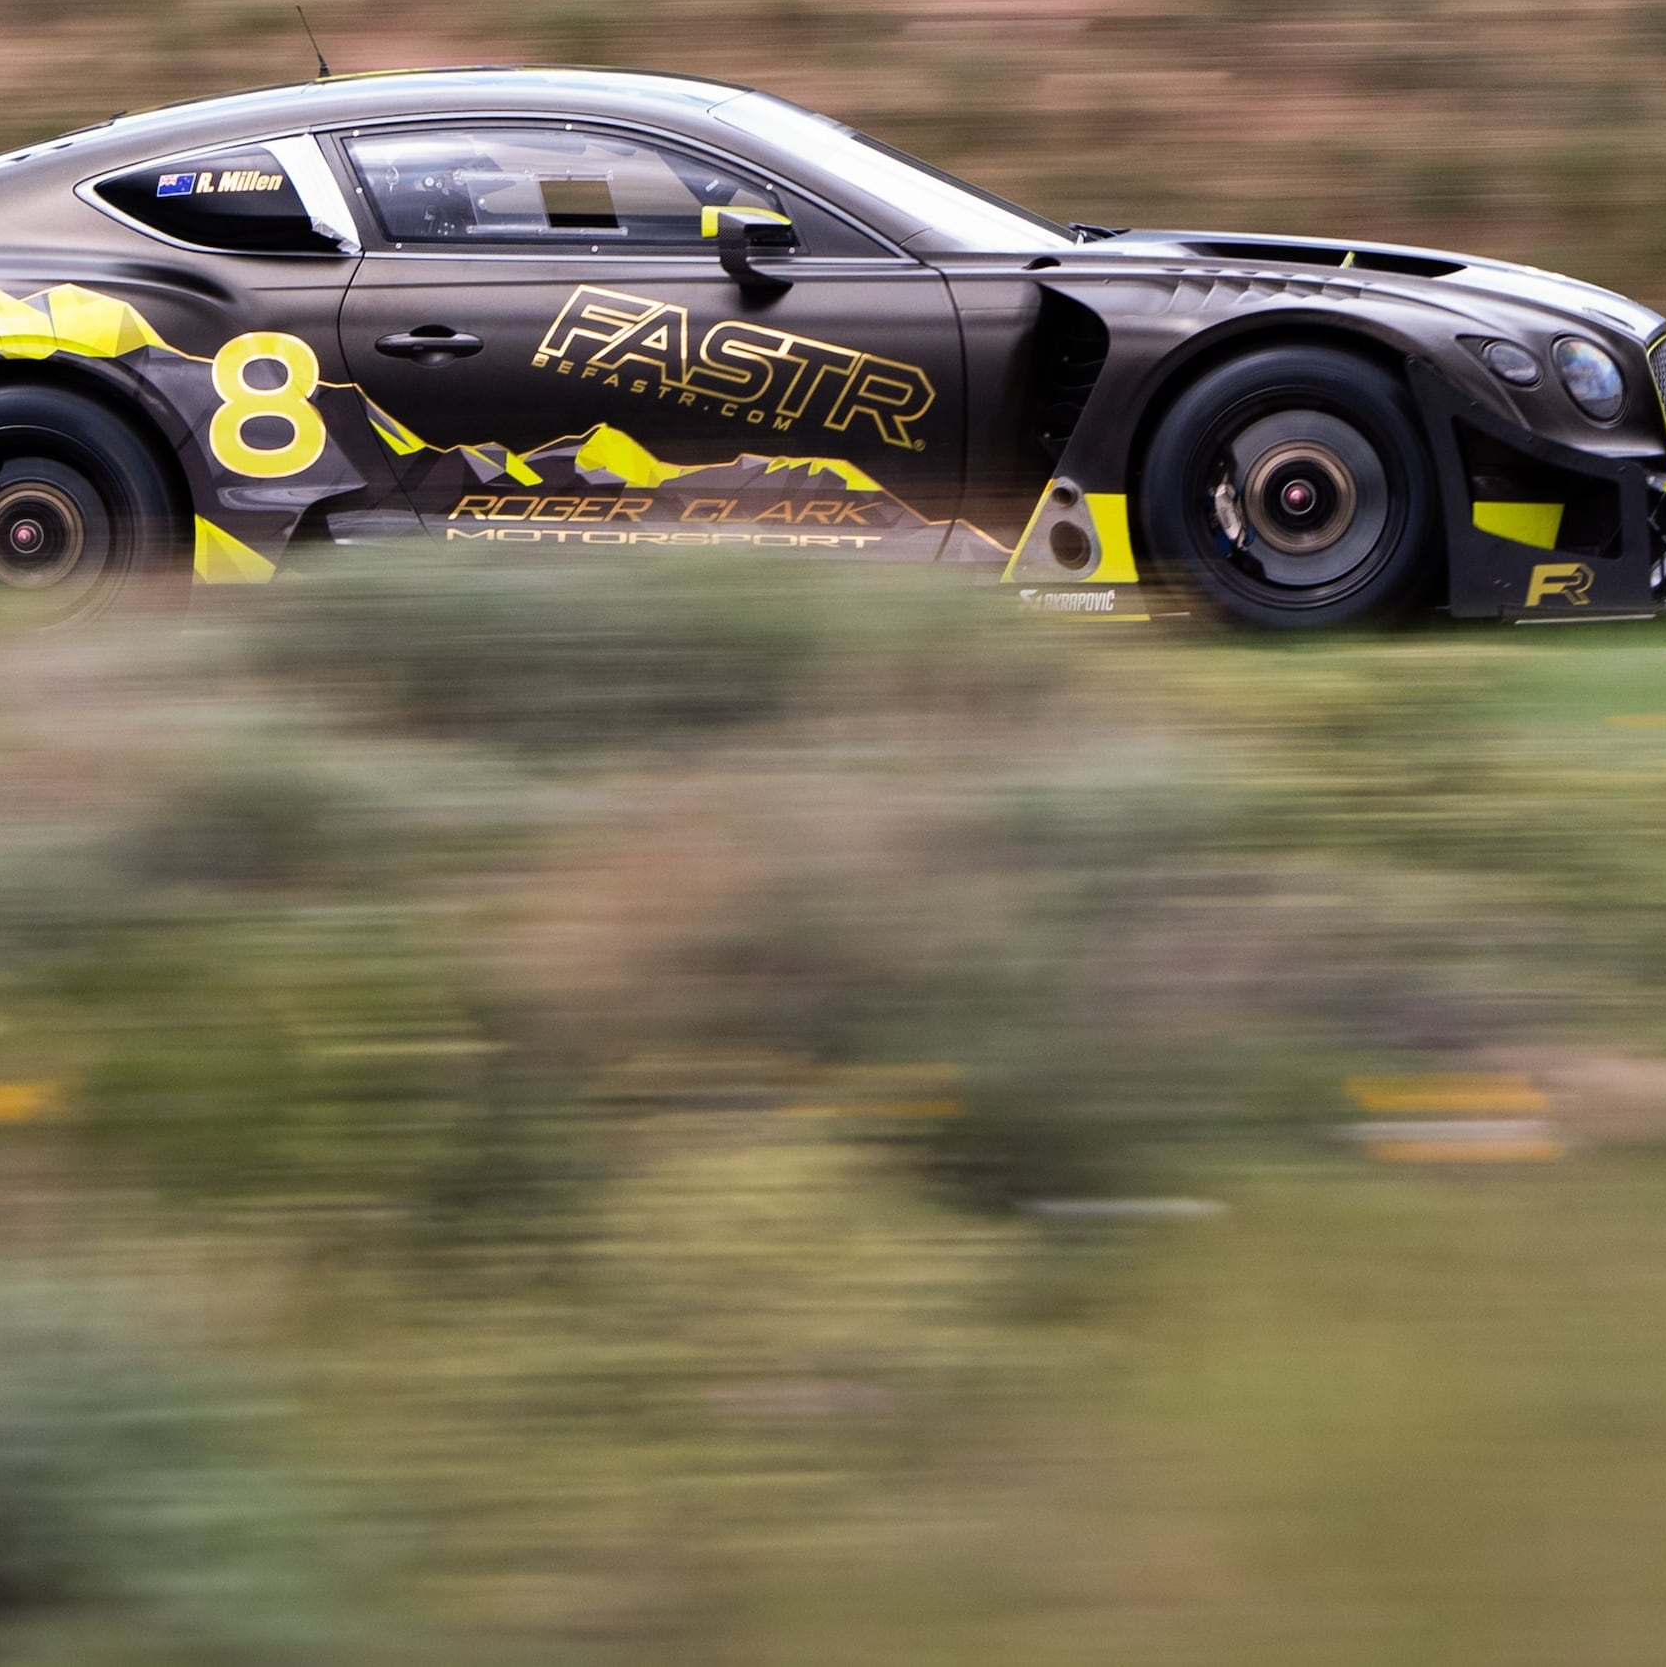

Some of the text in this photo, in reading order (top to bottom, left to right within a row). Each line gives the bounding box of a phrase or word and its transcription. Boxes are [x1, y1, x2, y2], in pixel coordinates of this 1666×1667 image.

[196, 170, 283, 194] R. Millen
[209, 331, 327, 478] 8
[532, 352, 792, 431] BEFASTR.COM
[447, 494, 883, 525] ROGER CLARK
[446, 528, 882, 549] MOTORSPORT
